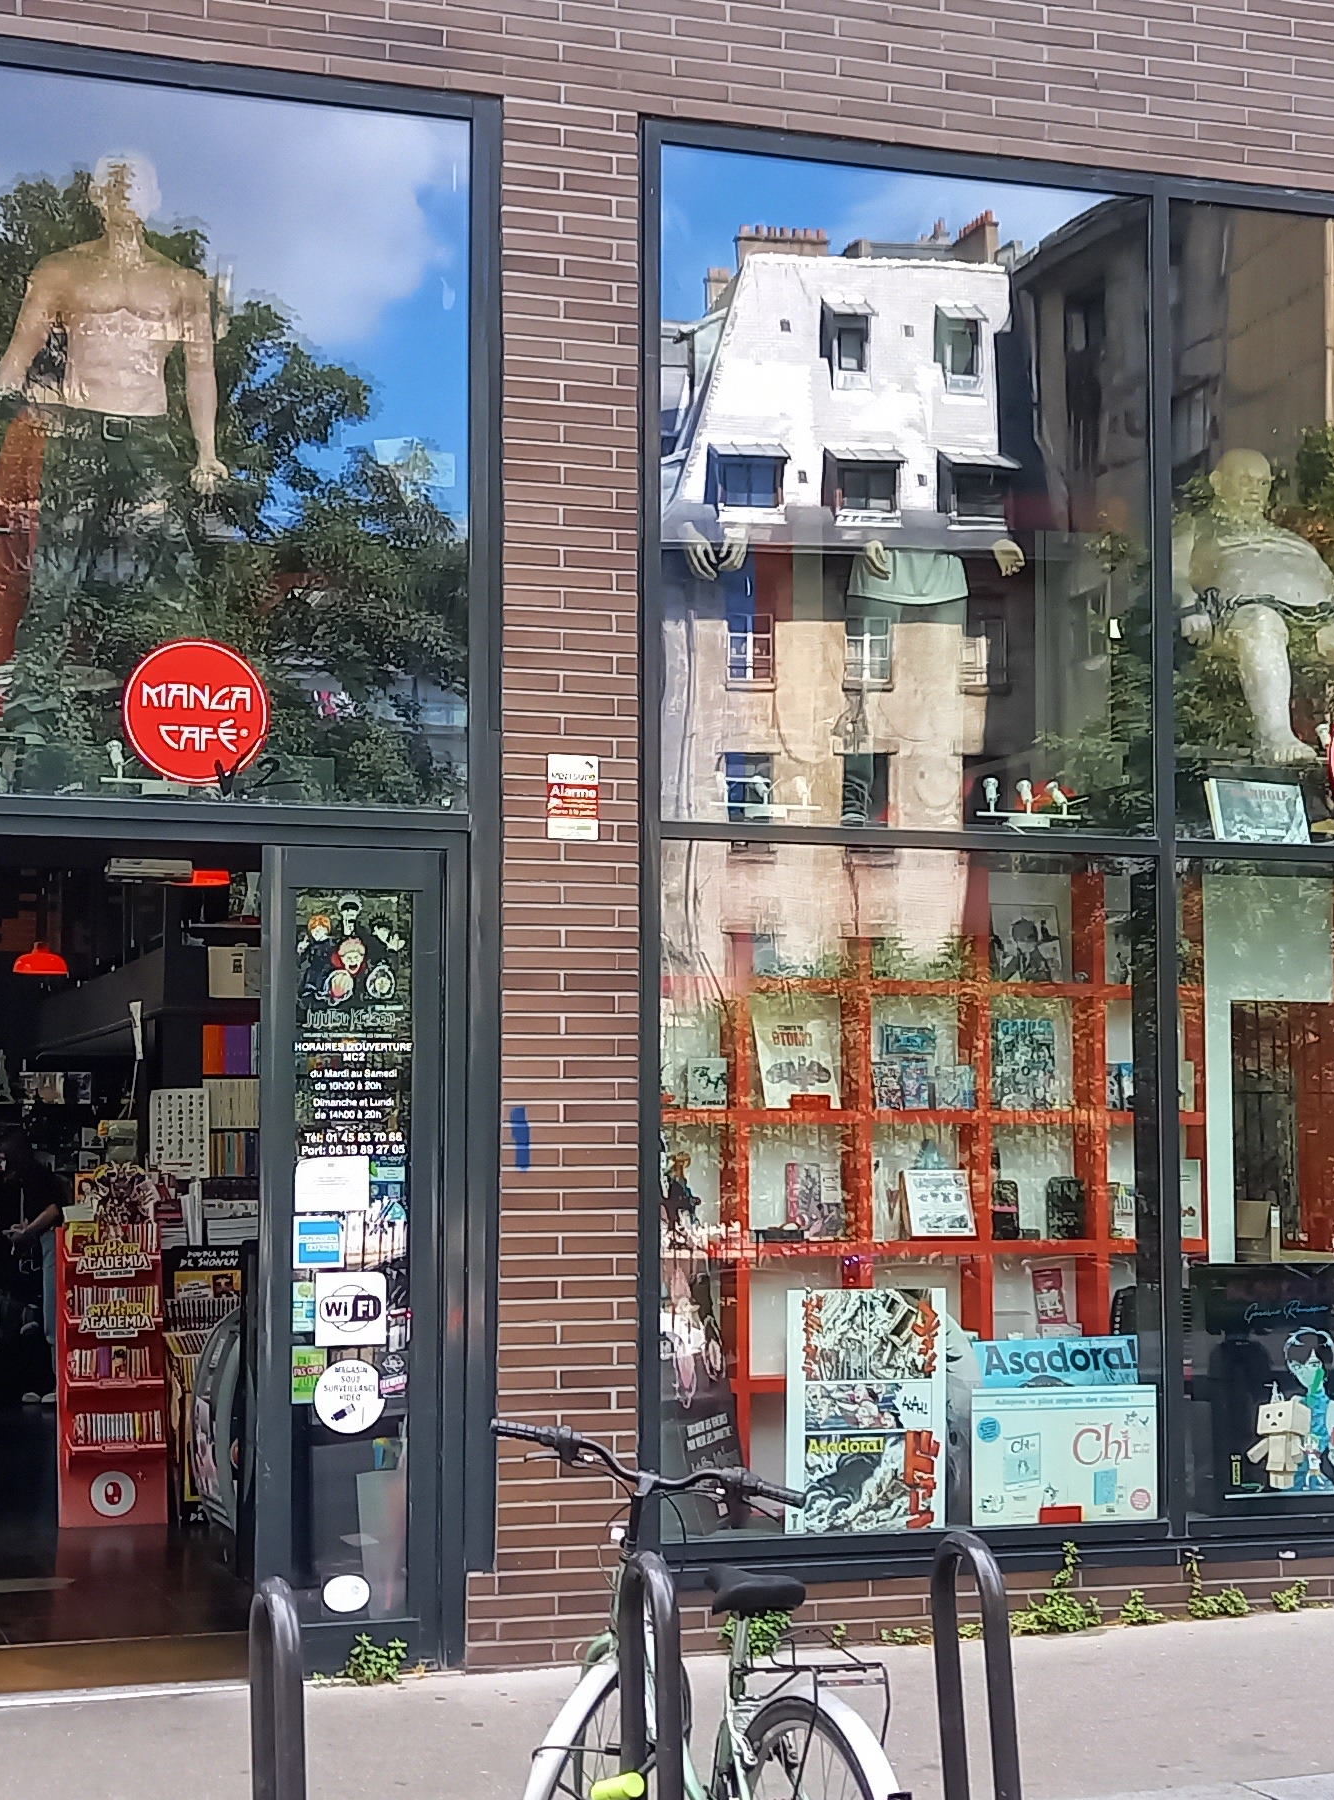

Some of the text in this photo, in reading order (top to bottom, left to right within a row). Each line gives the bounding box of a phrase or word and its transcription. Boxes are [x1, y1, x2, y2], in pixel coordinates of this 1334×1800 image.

[141, 682, 252, 712] MANGA
[159, 718, 239, 754] CAFÉ
[549, 784, 597, 798] Alarme
[294, 1042, 345, 1051] HORAIRES
[342, 1053, 365, 1061] MC2
[310, 1069, 322, 1078] du
[324, 1069, 349, 1078] Mardi
[364, 1069, 398, 1078] Samedi
[313, 1098, 394, 1107] Dimanche et Lundi
[326, 1133, 338, 1142] 01
[341, 1133, 355, 1142] 45
[301, 1145, 326, 1155] Port:
[328, 1145, 343, 1154] 06
[346, 1145, 358, 1154] 19
[376, 1145, 389, 1154] 27
[392, 1144, 405, 1154] 05
[77, 1254, 151, 1273] ACADEMIA
[179, 1258, 194, 1268] DE
[80, 1314, 154, 1332] ACADEMIA
[984, 1338, 1138, 1377] Asadora!
[807, 1437, 884, 1455] Asadora!
[1072, 1423, 1132, 1466] Chi
